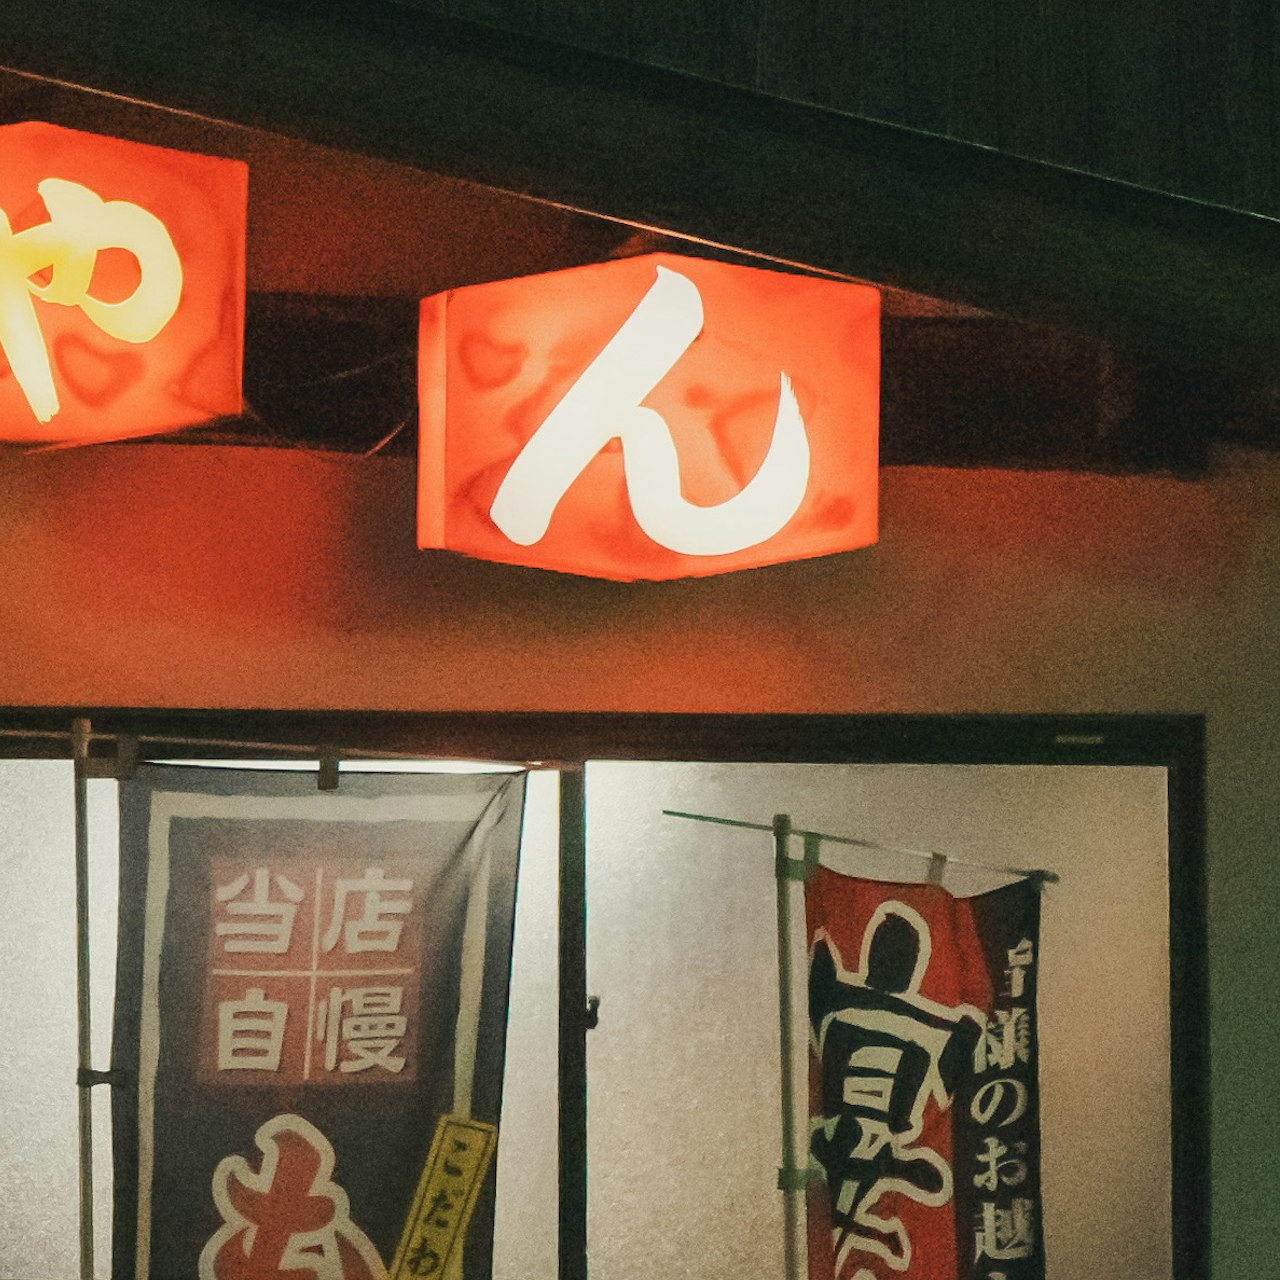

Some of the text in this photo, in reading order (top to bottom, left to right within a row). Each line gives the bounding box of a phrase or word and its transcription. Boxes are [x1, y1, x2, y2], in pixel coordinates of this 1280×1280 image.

[488, 264, 810, 557] ん
[215, 866, 414, 955] 当店
[217, 985, 409, 1075] 自慢
